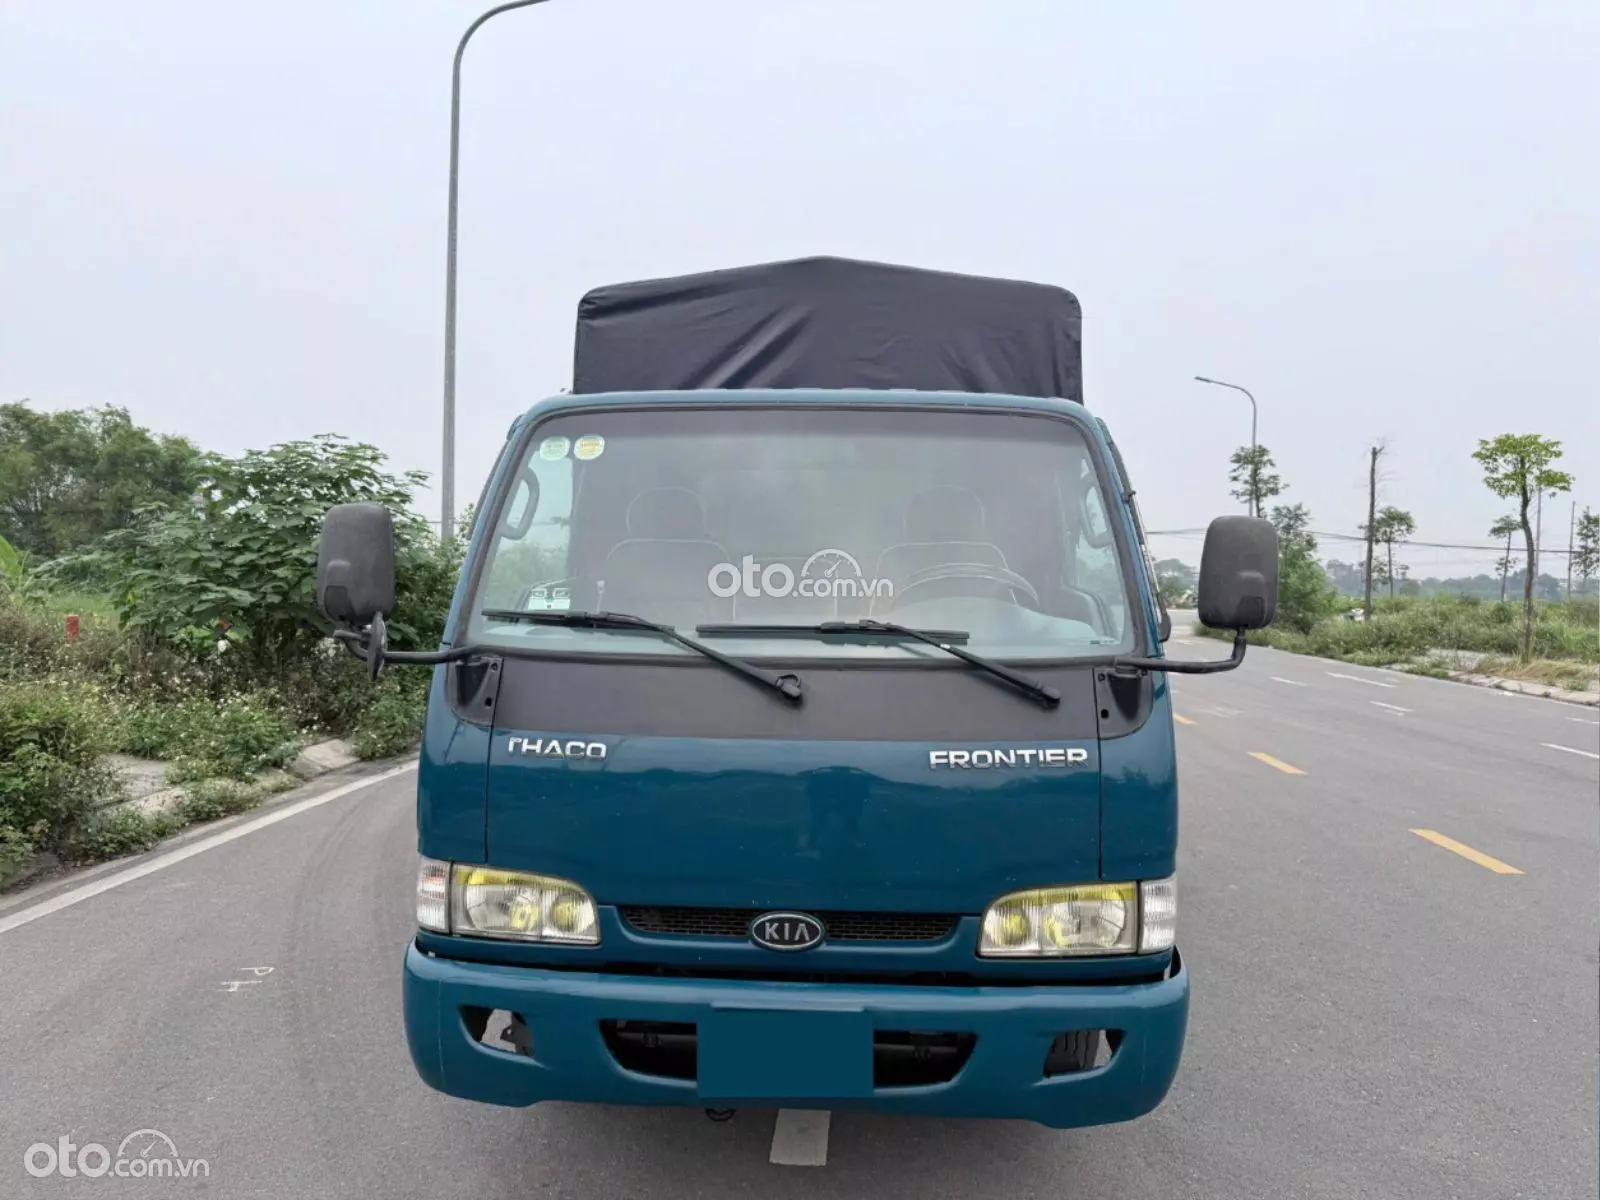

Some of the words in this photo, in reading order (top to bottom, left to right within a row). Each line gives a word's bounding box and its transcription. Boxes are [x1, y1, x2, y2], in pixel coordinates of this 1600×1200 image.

[507, 736, 607, 759] THACO
[929, 748, 1089, 769] FRONTIER
[764, 921, 811, 941] KIA
